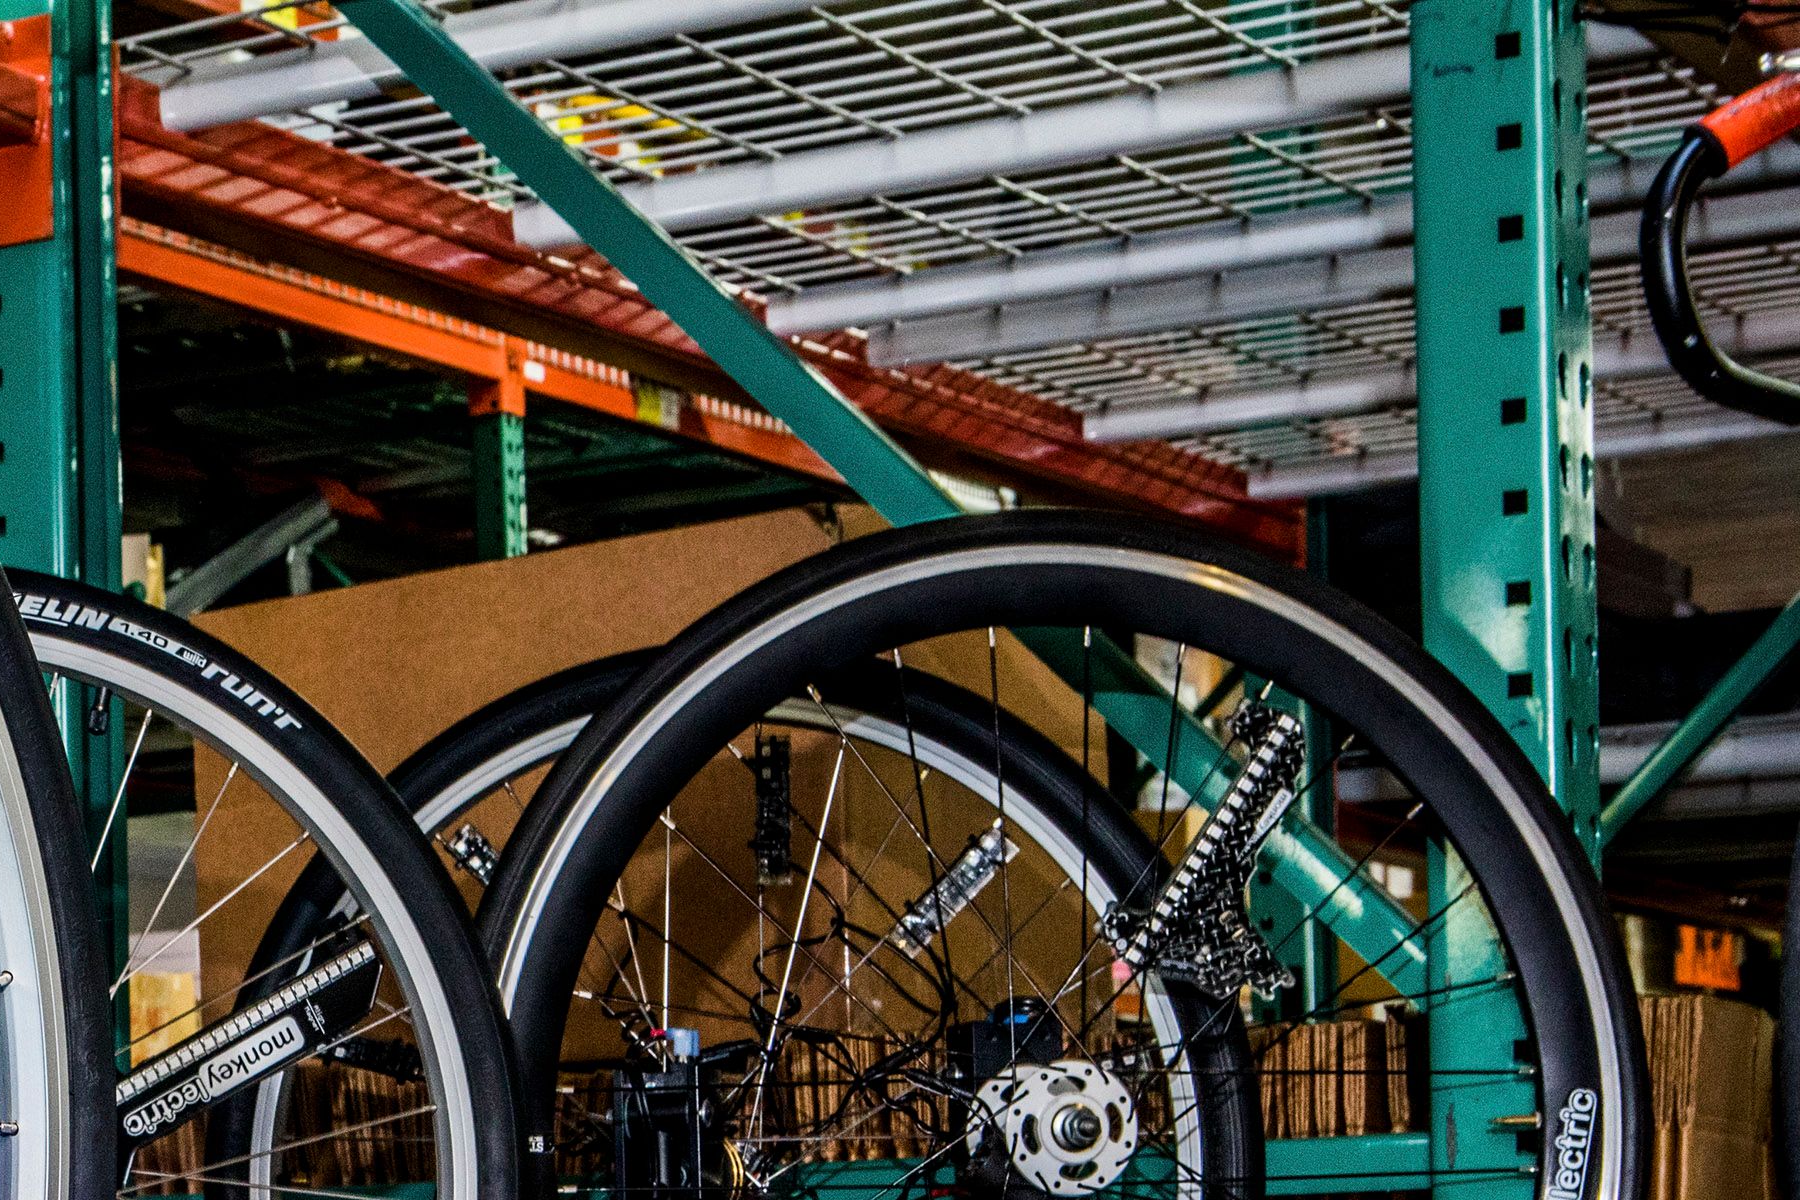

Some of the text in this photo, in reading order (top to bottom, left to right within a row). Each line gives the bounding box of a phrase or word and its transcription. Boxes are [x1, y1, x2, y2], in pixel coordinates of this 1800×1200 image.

[13, 592, 110, 632] ELIN
[119, 622, 169, 650] 1.40
[182, 648, 208, 669] wild
[124, 1026, 295, 1136] monkeylectric
